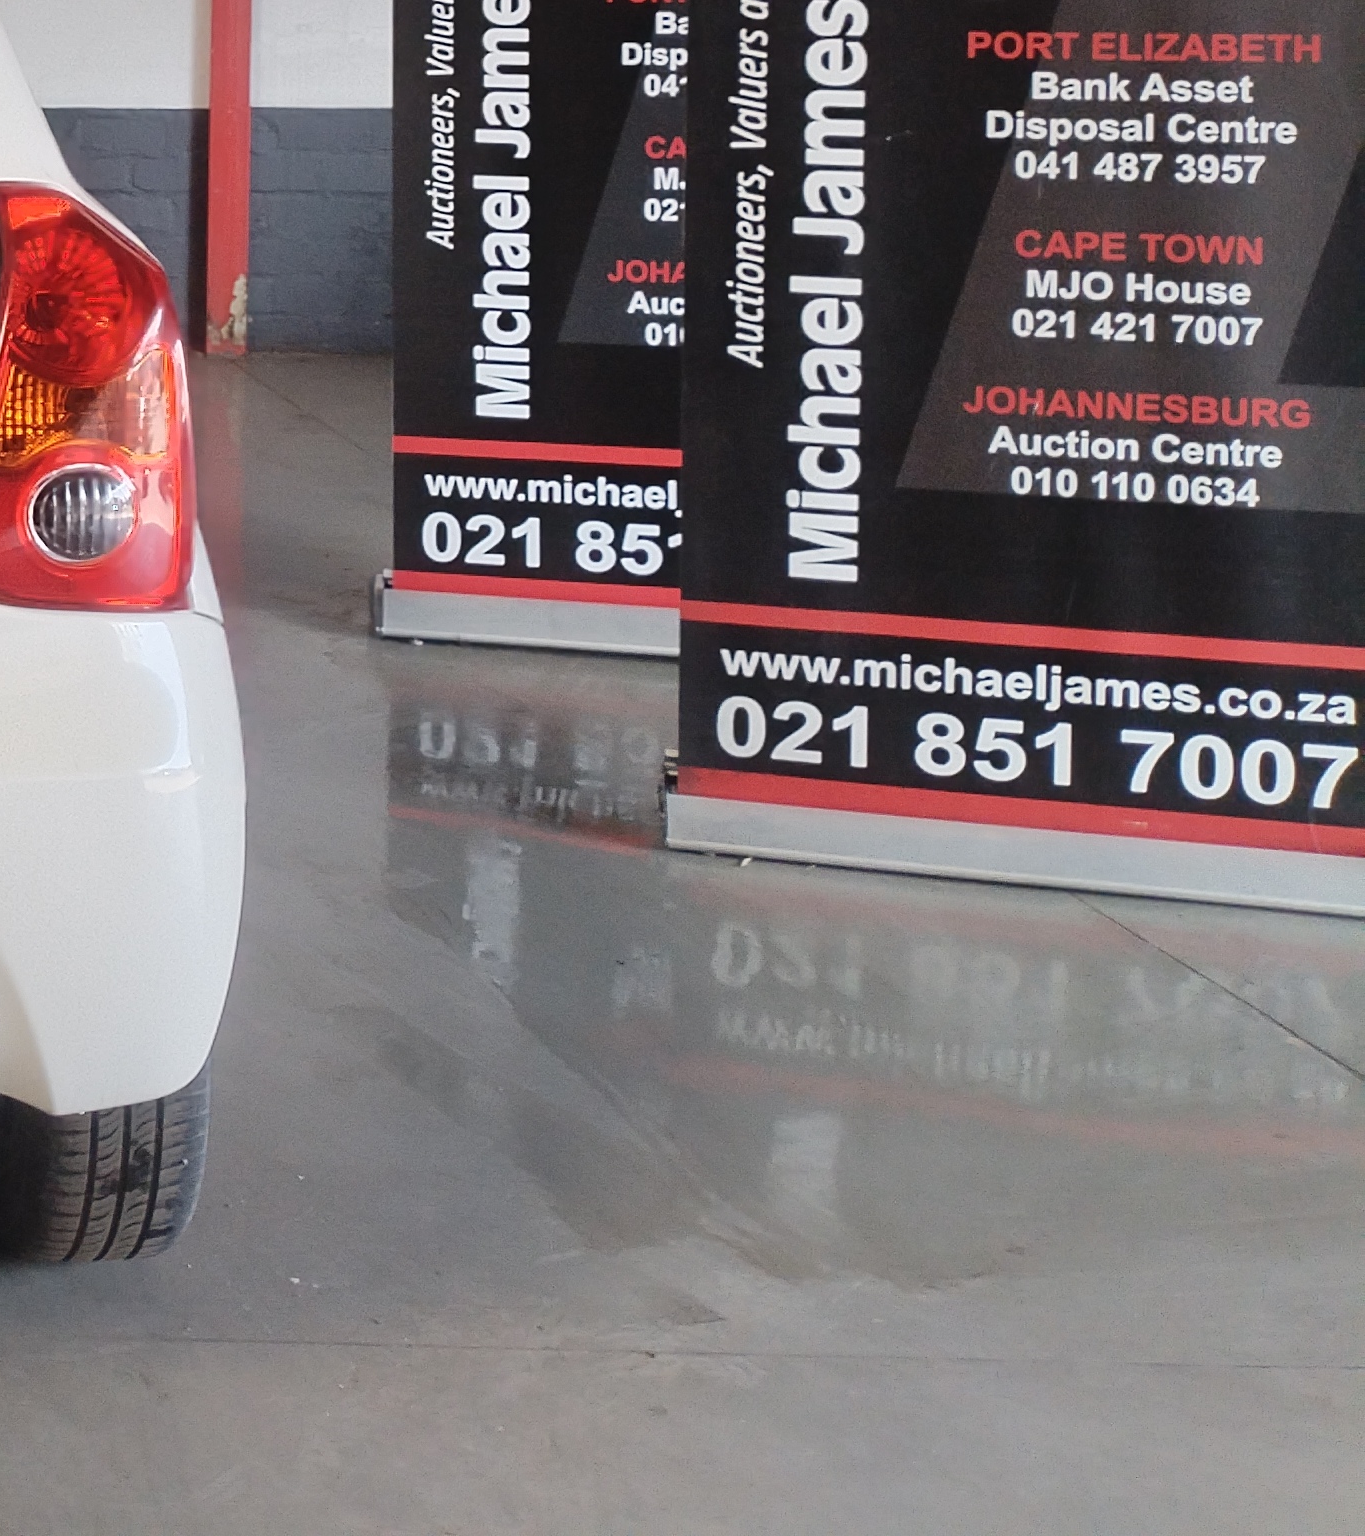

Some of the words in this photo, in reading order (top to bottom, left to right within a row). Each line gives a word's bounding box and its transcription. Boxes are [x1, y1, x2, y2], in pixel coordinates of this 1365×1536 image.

[967, 31, 1080, 60] PORT
[1092, 32, 1321, 62] ELIZABETH
[728, 28, 768, 148] Valuers
[1032, 71, 1131, 101] Bank
[1140, 73, 1254, 103] Asset
[986, 110, 1154, 147] Disposal
[1168, 113, 1297, 144] Centre
[424, 88, 460, 249] Auctioneers,
[1015, 150, 1078, 180] 041
[1093, 152, 1163, 181] 487
[1175, 154, 1266, 184] 3957
[726, 165, 774, 368] Auctioneers,
[1015, 229, 1126, 261] CAPE
[1139, 233, 1263, 265] TOWN
[473, 175, 531, 419] Michael
[1026, 270, 1113, 300] MJO
[1126, 273, 1251, 305] House
[1012, 309, 1075, 339] 021
[1090, 312, 1154, 342] 421
[1172, 315, 1263, 346] 7007
[963, 386, 1311, 428] JOHANNESBURG
[786, 276, 863, 582] Michael
[988, 426, 1139, 461] Auction
[1152, 434, 1283, 468] Centre
[1011, 466, 1078, 497] 010
[1091, 471, 1155, 502] 110
[1167, 474, 1260, 507] 0634
[422, 512, 540, 568] 021
[717, 649, 1356, 726] www.michaeljames.co.za
[717, 696, 868, 768] 021
[915, 713, 1072, 786] 851
[1121, 729, 1358, 809] 7007
